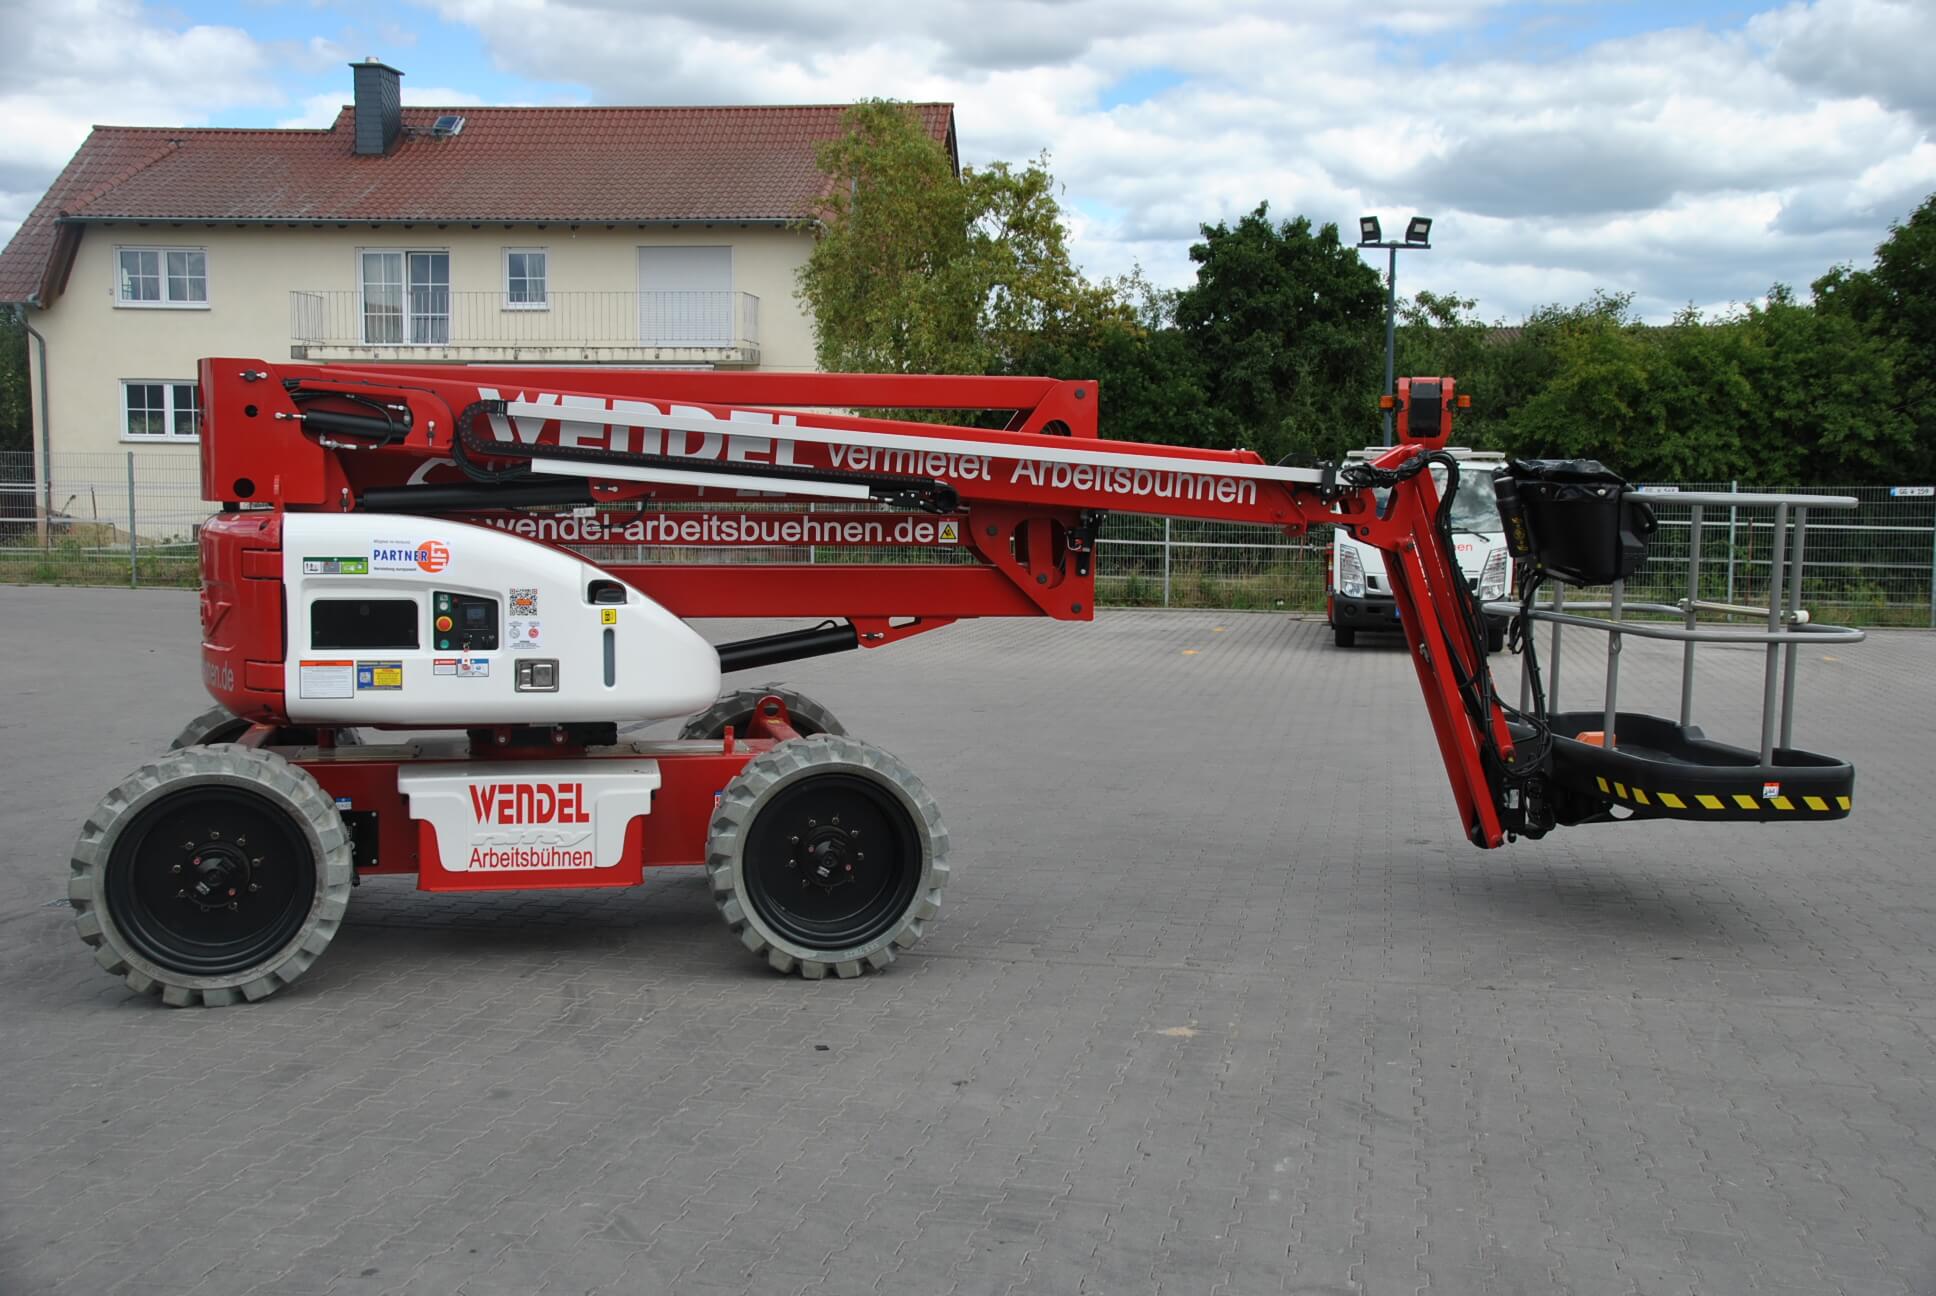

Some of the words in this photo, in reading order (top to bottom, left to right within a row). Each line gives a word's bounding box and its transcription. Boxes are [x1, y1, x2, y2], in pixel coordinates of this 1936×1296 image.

[478, 387, 814, 468] WENDEL
[373, 549, 428, 562] PARTNER
[469, 783, 590, 824] WENDEL
[469, 846, 593, 868] Arbeitsbühnen
